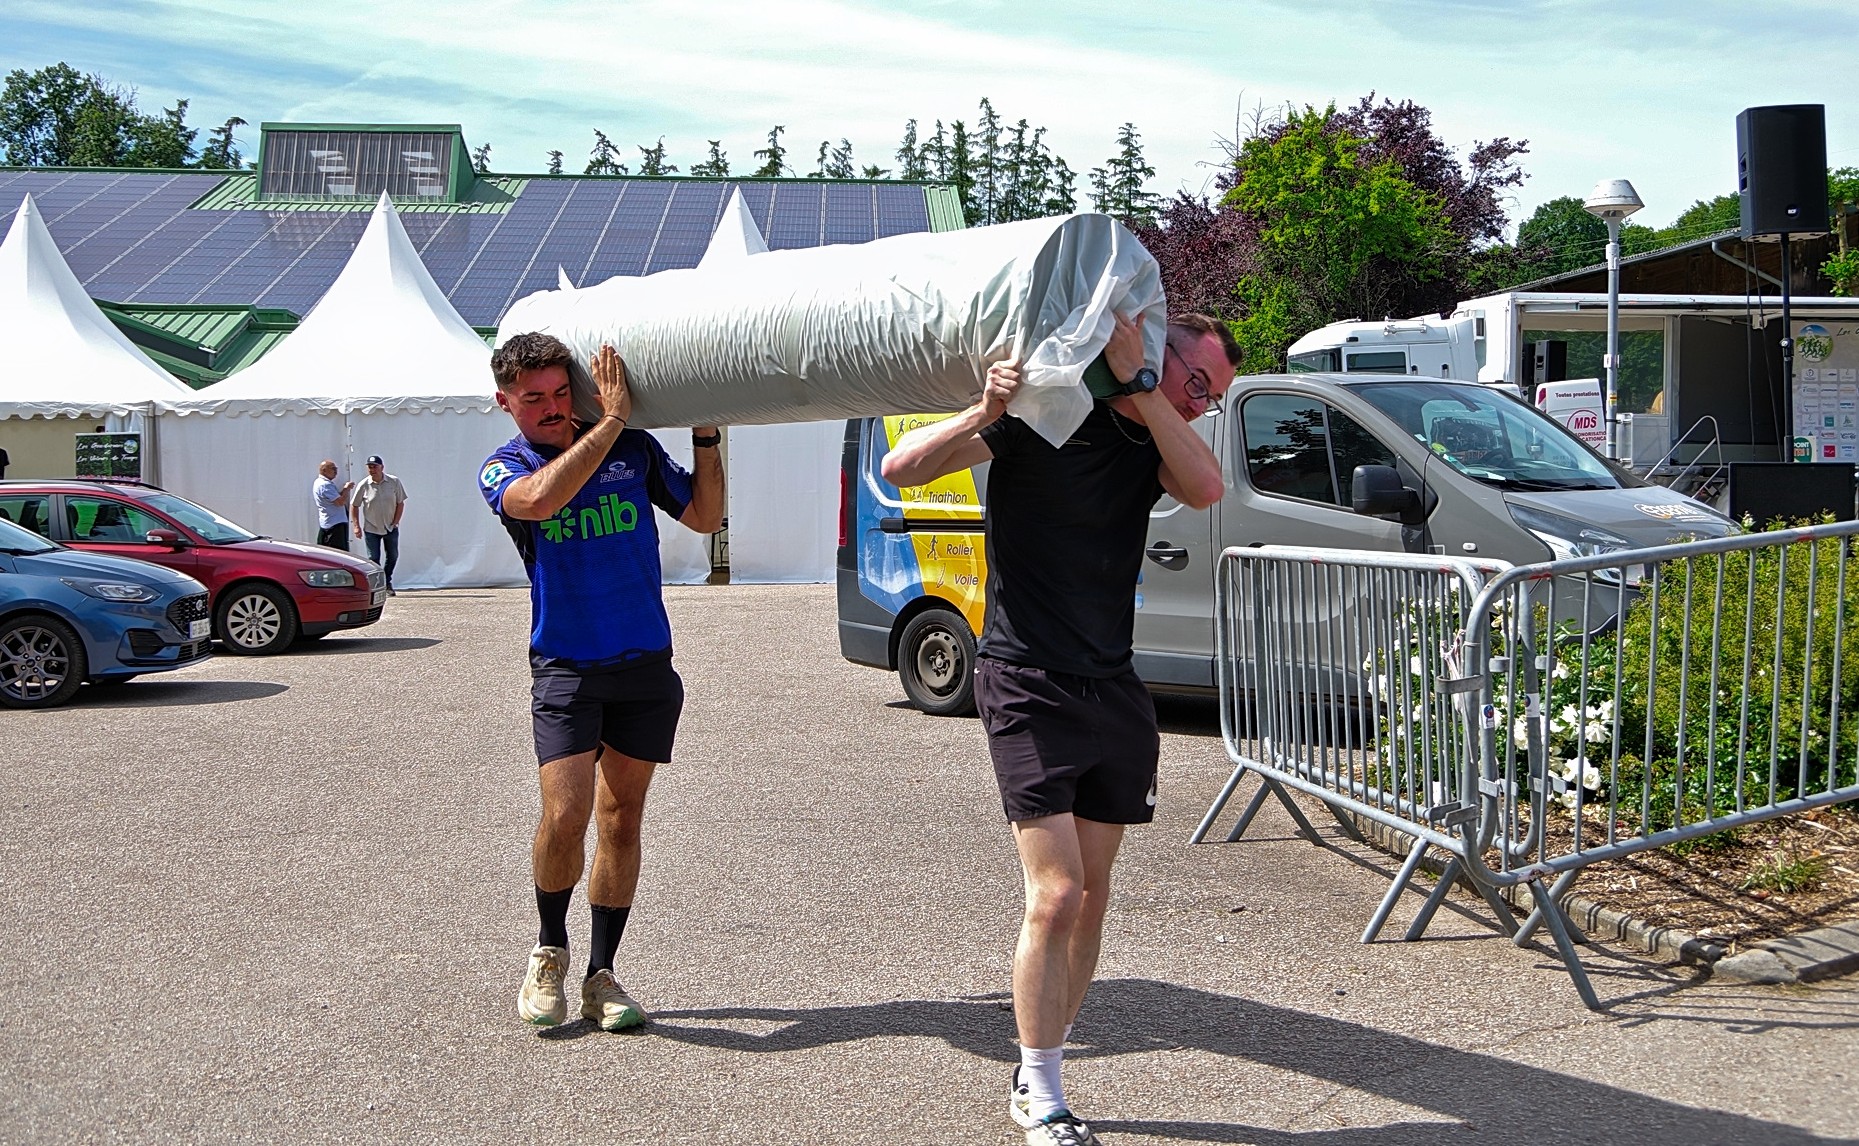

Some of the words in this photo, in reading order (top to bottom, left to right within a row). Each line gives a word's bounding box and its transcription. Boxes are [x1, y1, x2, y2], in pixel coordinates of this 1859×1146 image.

[1574, 416, 1597, 429] MDS
[600, 469, 635, 483] BLUES
[929, 491, 967, 504] Triathlon
[580, 493, 638, 539] nib
[946, 543, 974, 556] Roller
[954, 574, 979, 586] Voile
